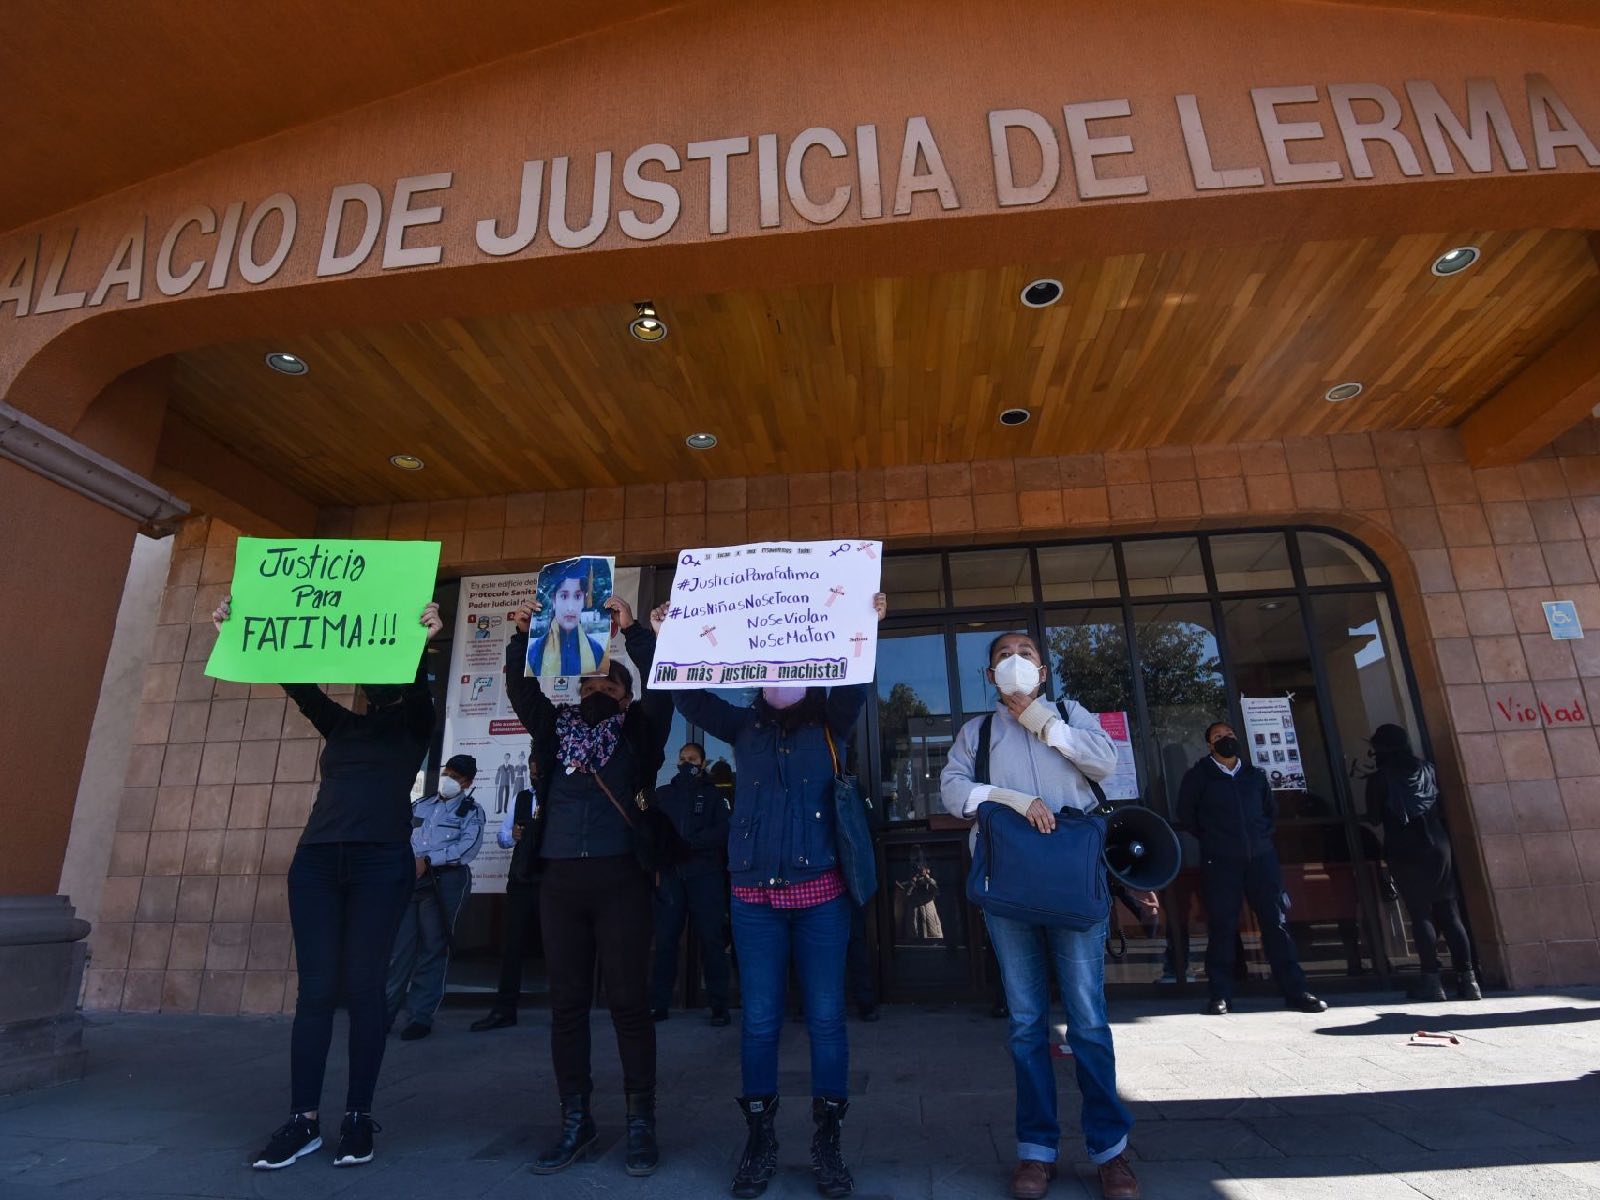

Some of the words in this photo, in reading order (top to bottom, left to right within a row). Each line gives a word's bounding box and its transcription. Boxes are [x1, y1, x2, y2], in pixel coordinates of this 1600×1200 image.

[316, 171, 453, 278] DE
[475, 114, 960, 257] JUSTICIA
[988, 98, 1149, 208] DE
[1175, 72, 1600, 190] LERMA
[259, 543, 366, 582] Justicia
[471, 582, 480, 590] En
[481, 582, 496, 590] este
[498, 580, 523, 590] edificio
[677, 565, 820, 592] #JusticiaParaFatima
[291, 584, 342, 609] Para
[468, 601, 490, 609] Poder
[668, 591, 810, 619] #LasNiñasNoSeTocan
[747, 607, 829, 629] NoSeViolan
[242, 612, 397, 652] FATIMA!!!
[748, 625, 836, 650] NoSeMatan
[686, 665, 714, 682] más
[719, 663, 768, 684] justicia
[777, 661, 845, 680] machista!
